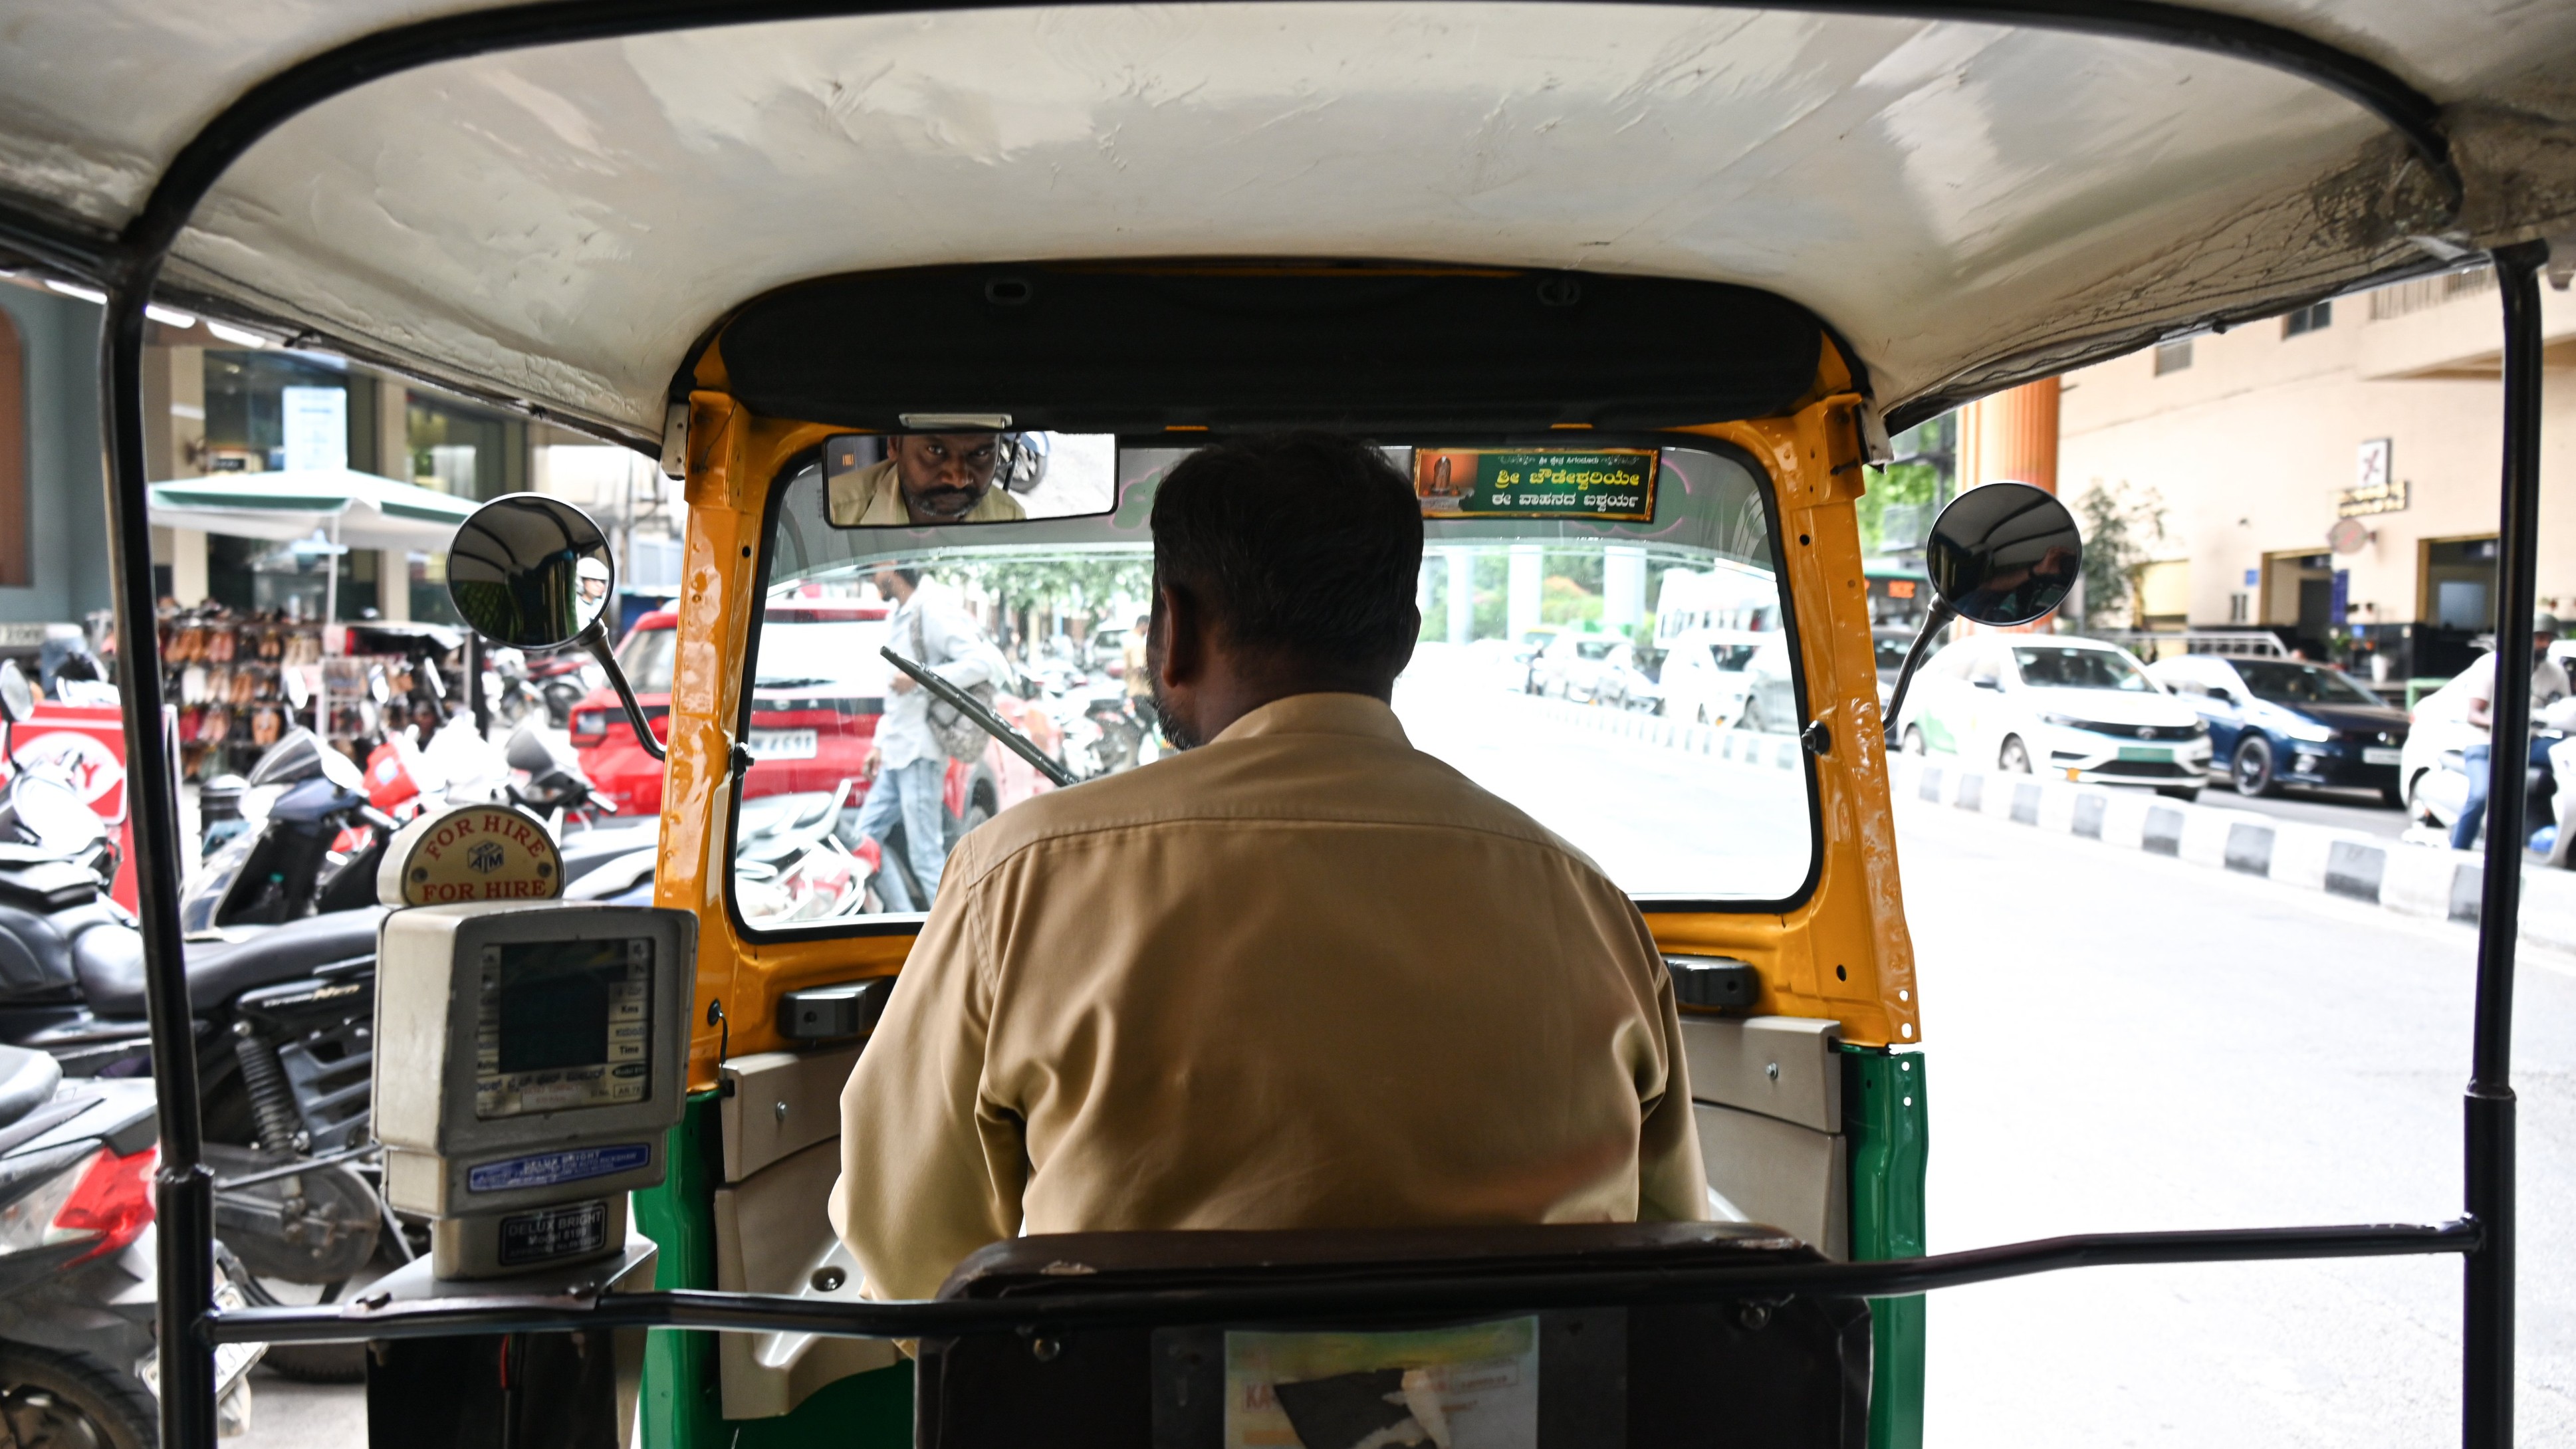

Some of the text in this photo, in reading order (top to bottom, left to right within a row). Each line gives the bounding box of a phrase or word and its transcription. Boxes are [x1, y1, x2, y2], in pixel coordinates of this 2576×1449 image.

[1495, 470, 1520, 489] ಶ್ರೀ
[1492, 493, 1512, 505] ಈ
[1519, 492, 1576, 506] ವಾಹನದ
[424, 814, 546, 861] FOR HIRE
[422, 879, 547, 902] FOR HIRE
[620, 1046, 640, 1056] Time
[509, 1211, 602, 1236] DELUX BRIGHT
[528, 1232, 560, 1246] Model
